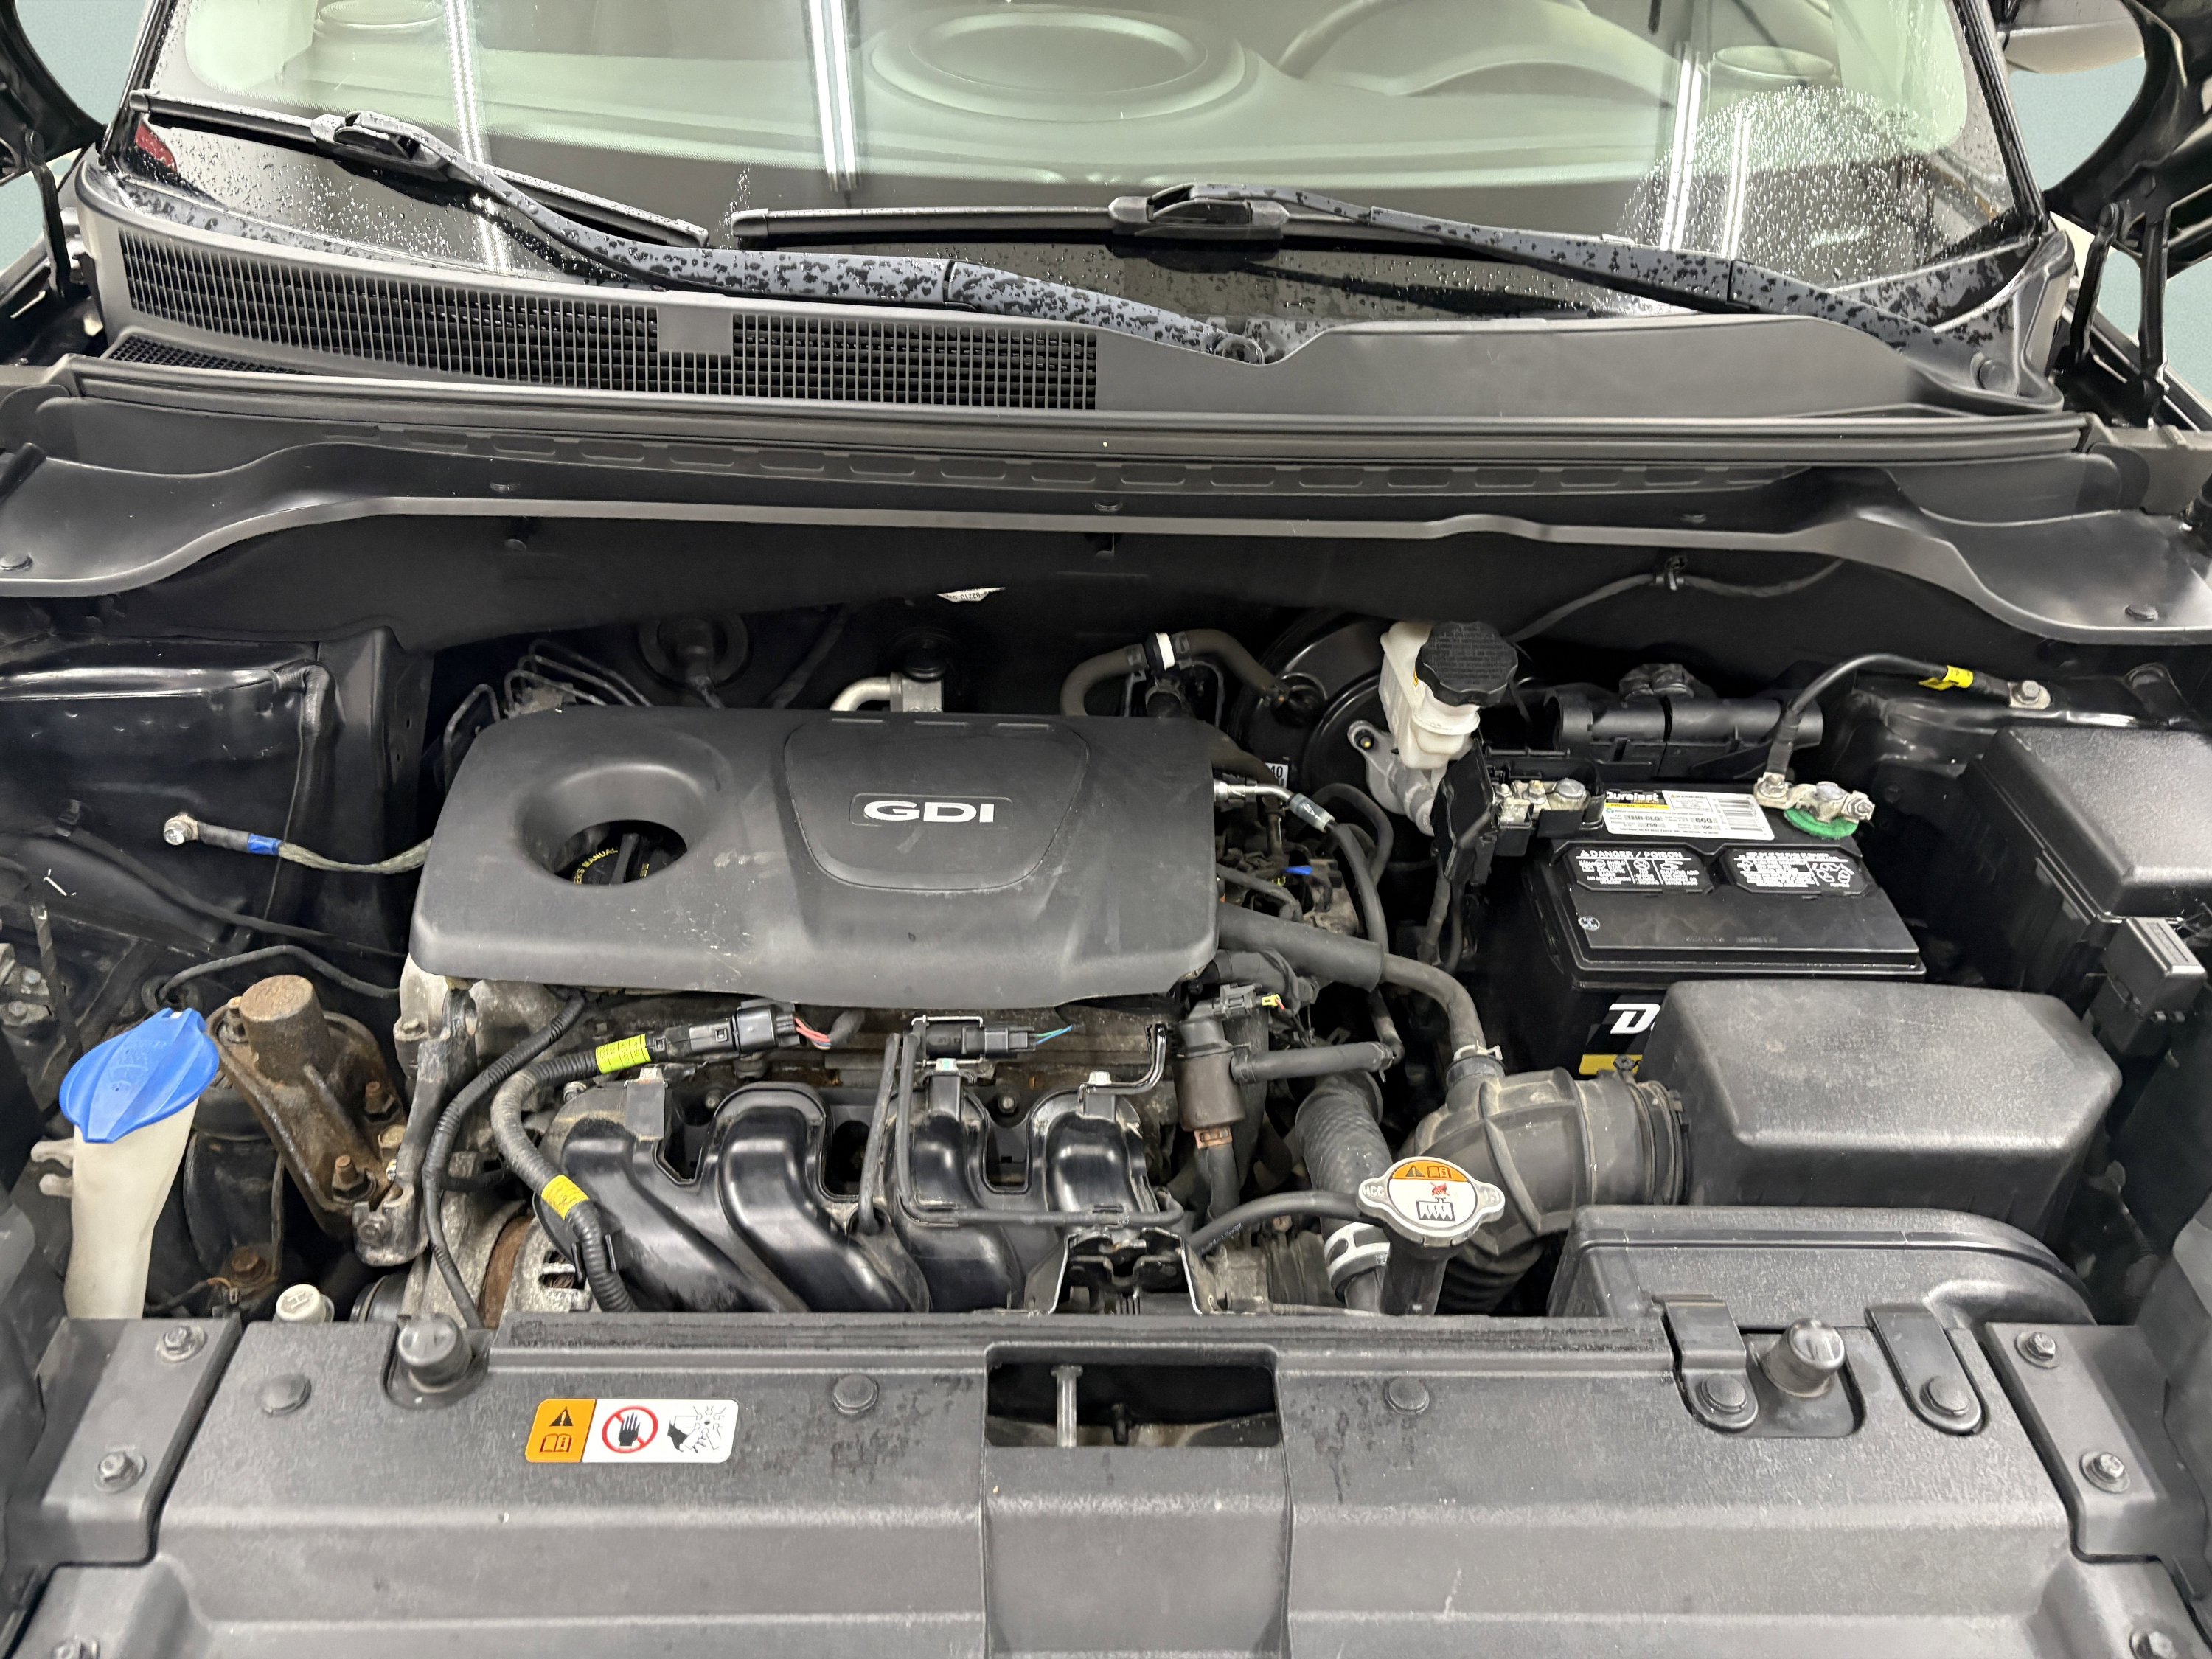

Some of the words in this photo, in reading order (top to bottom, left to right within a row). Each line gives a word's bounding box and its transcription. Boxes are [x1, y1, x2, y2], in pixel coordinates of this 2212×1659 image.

[864, 800, 994, 823] GDI
[581, 847, 619, 868] MANUAL
[1590, 850, 1634, 858] DANGER
[1644, 851, 1683, 859] POISON
[1363, 1184, 1385, 1197] HCC
